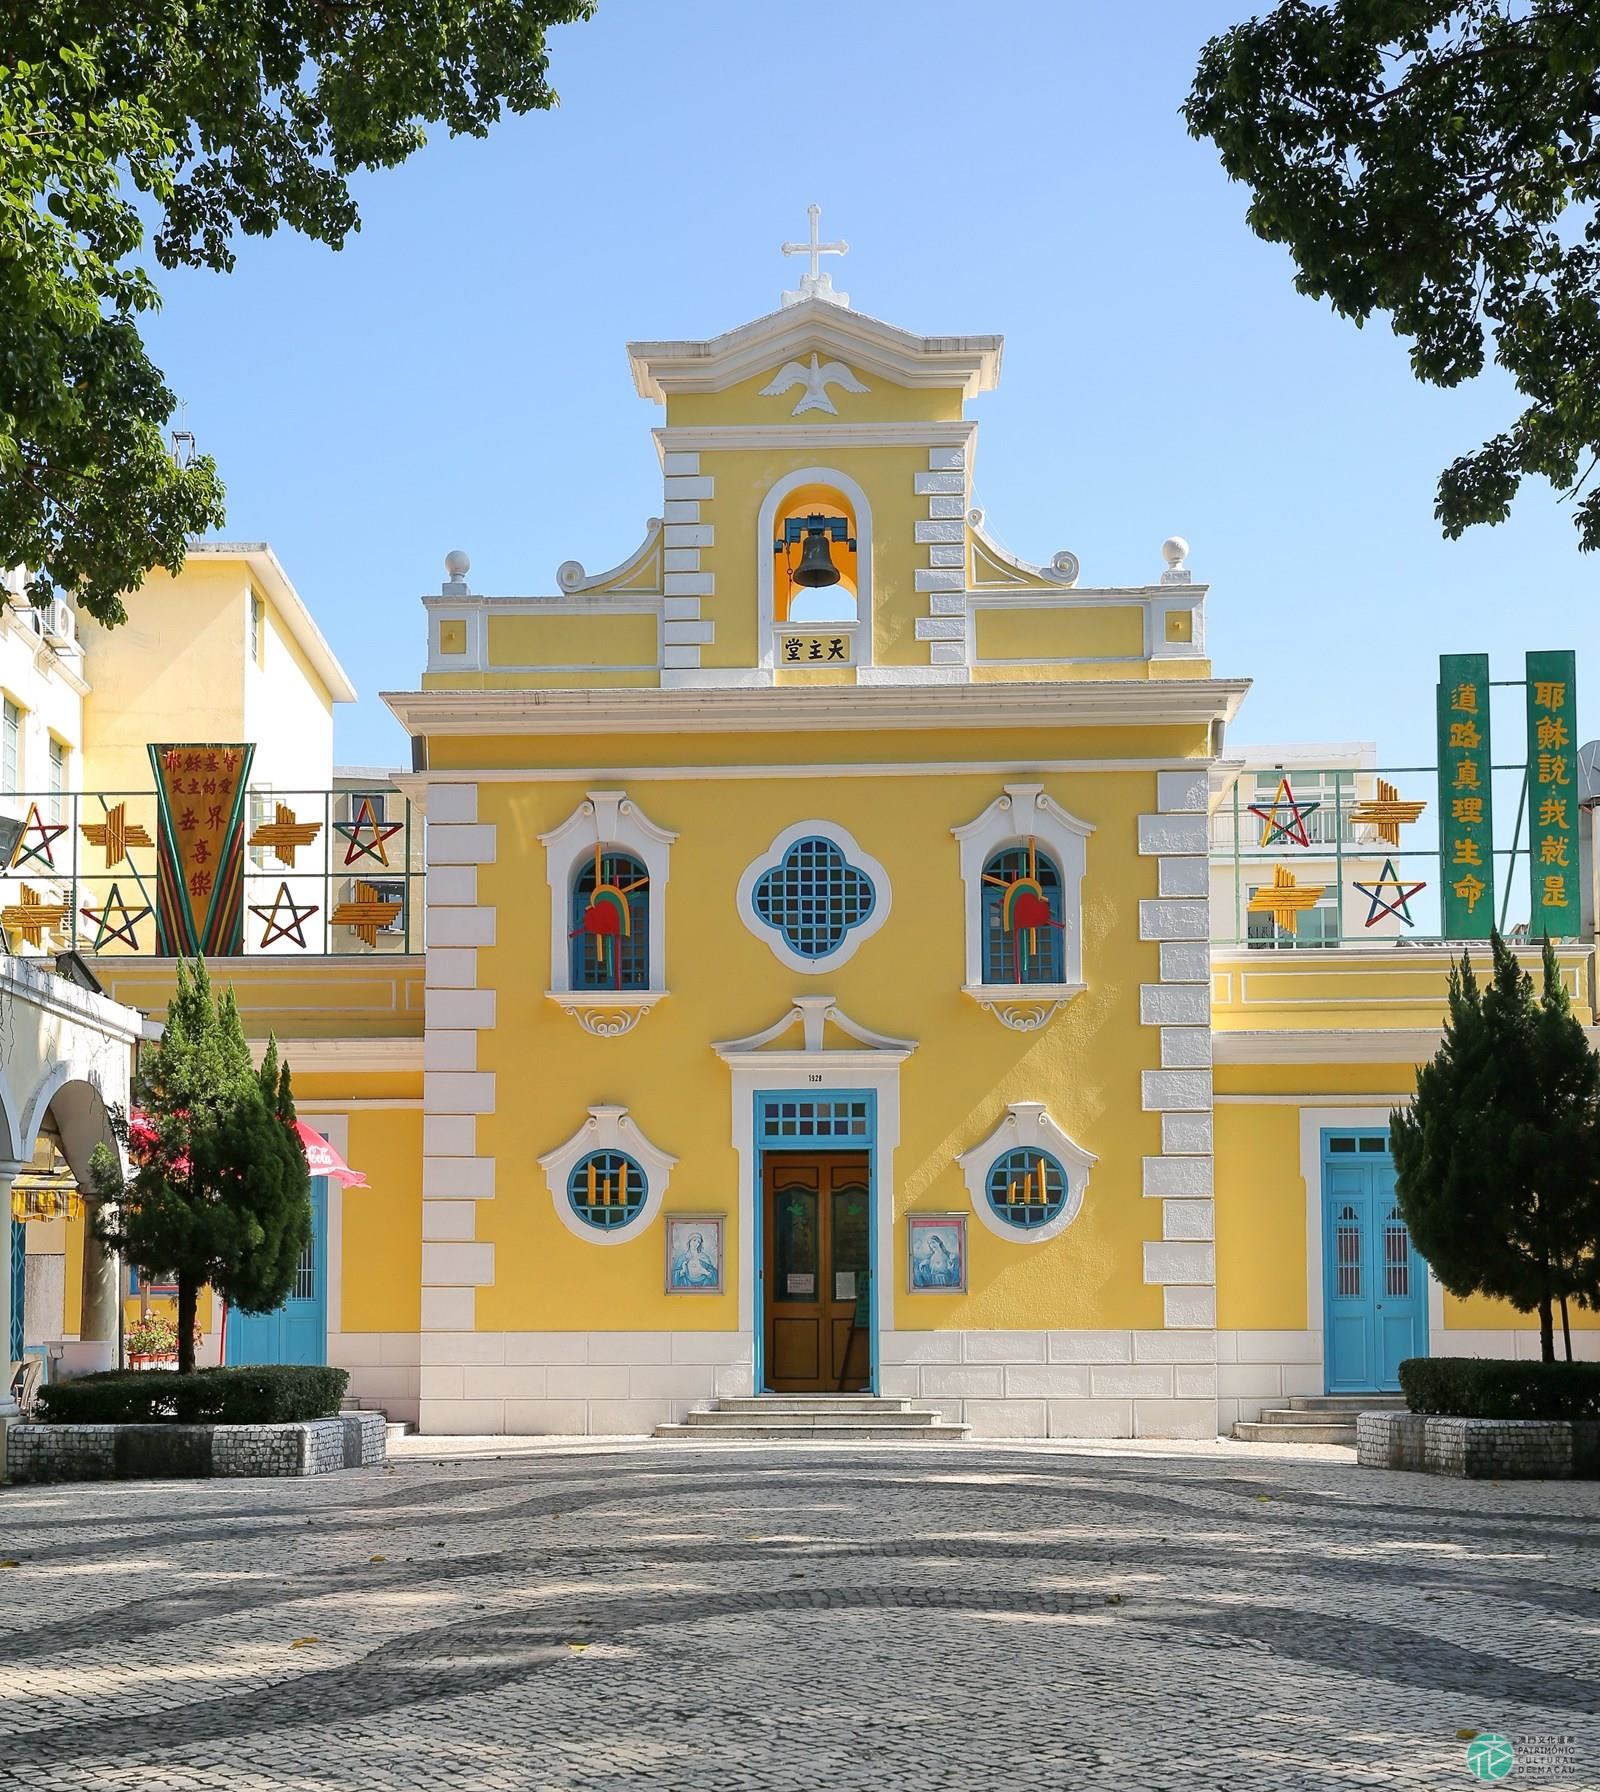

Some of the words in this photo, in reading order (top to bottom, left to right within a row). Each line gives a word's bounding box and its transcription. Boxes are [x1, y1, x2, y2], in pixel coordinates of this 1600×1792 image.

[785, 638, 845, 661] 天主堂
[165, 752, 239, 774] 耶穌基督
[808, 1074, 822, 1082] 1928
